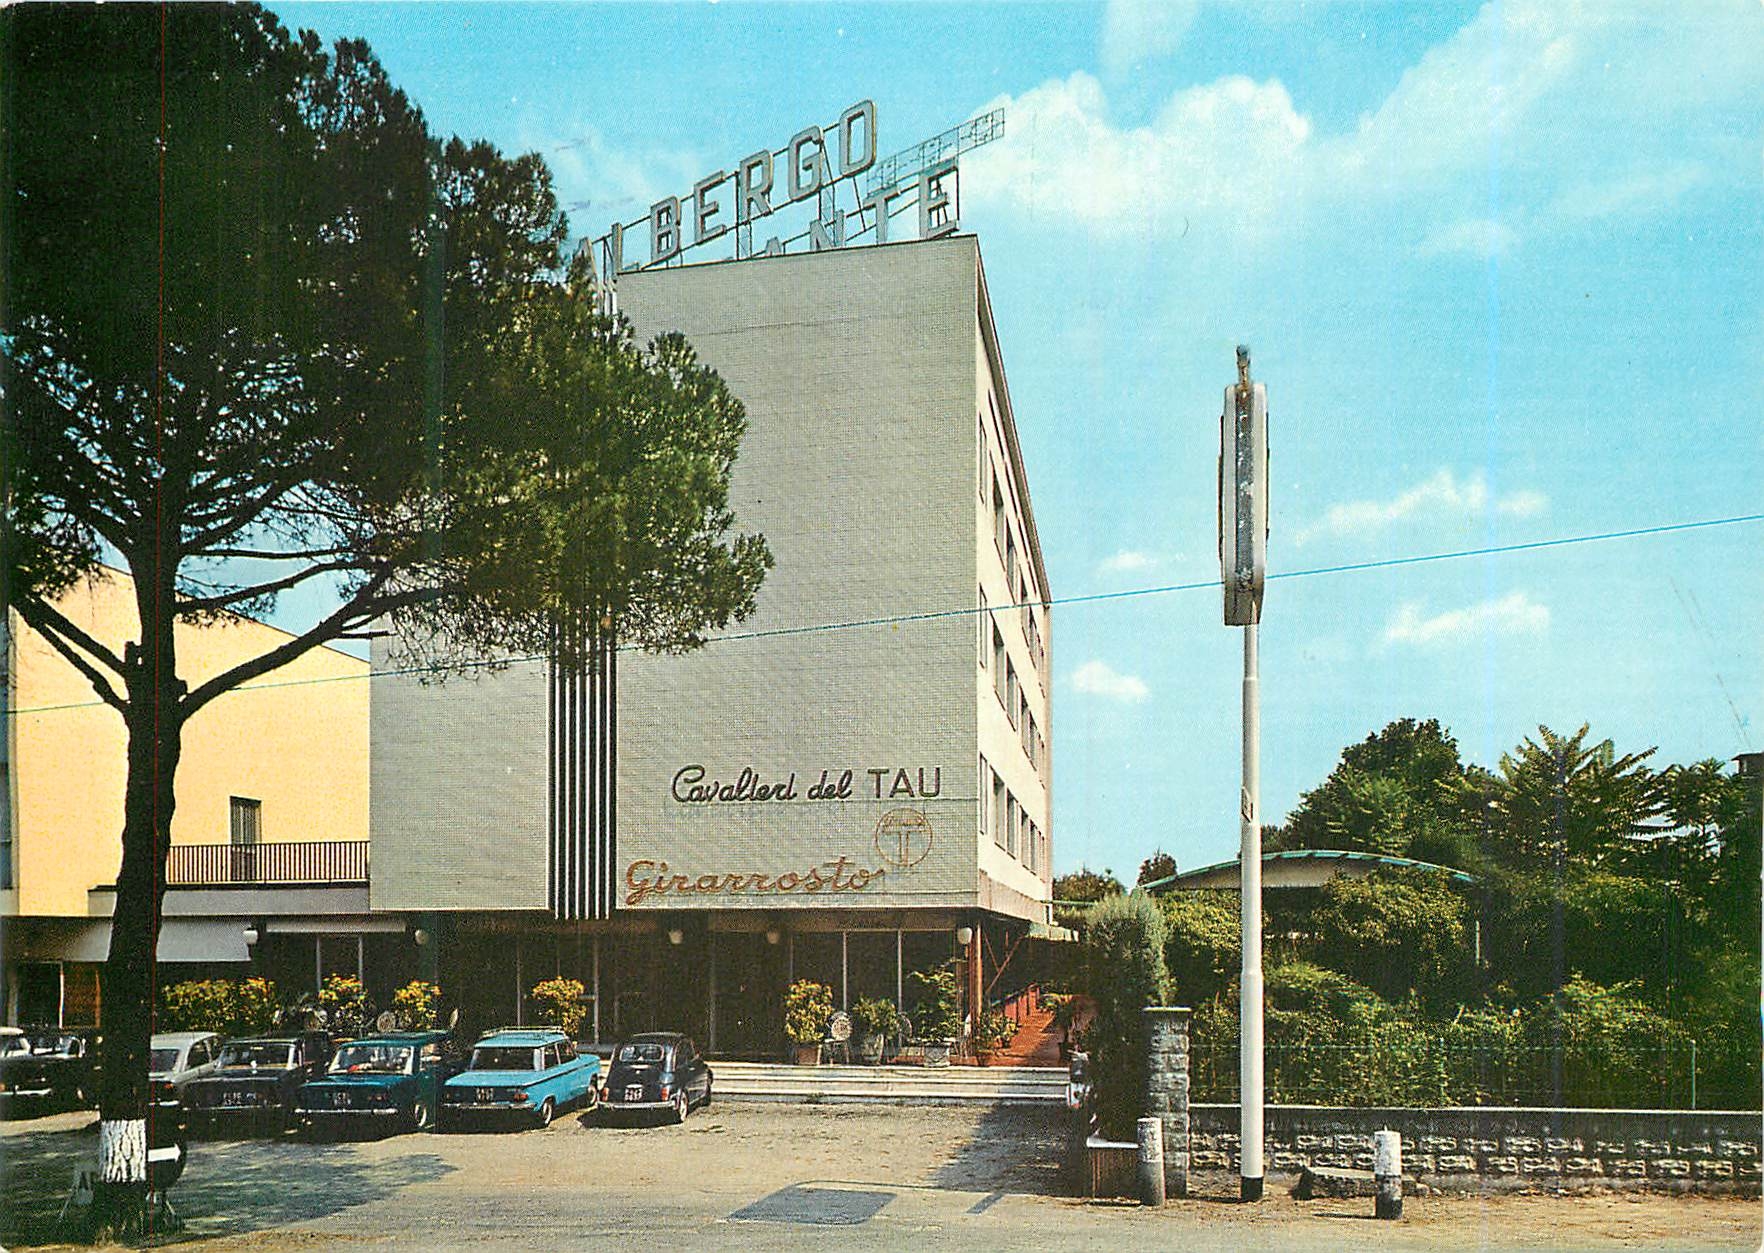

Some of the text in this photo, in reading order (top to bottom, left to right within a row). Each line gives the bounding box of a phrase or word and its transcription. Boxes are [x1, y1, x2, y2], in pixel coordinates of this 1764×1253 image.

[672, 764, 942, 803] Cavalieri del TAU
[625, 855, 887, 906] Girarrosto
